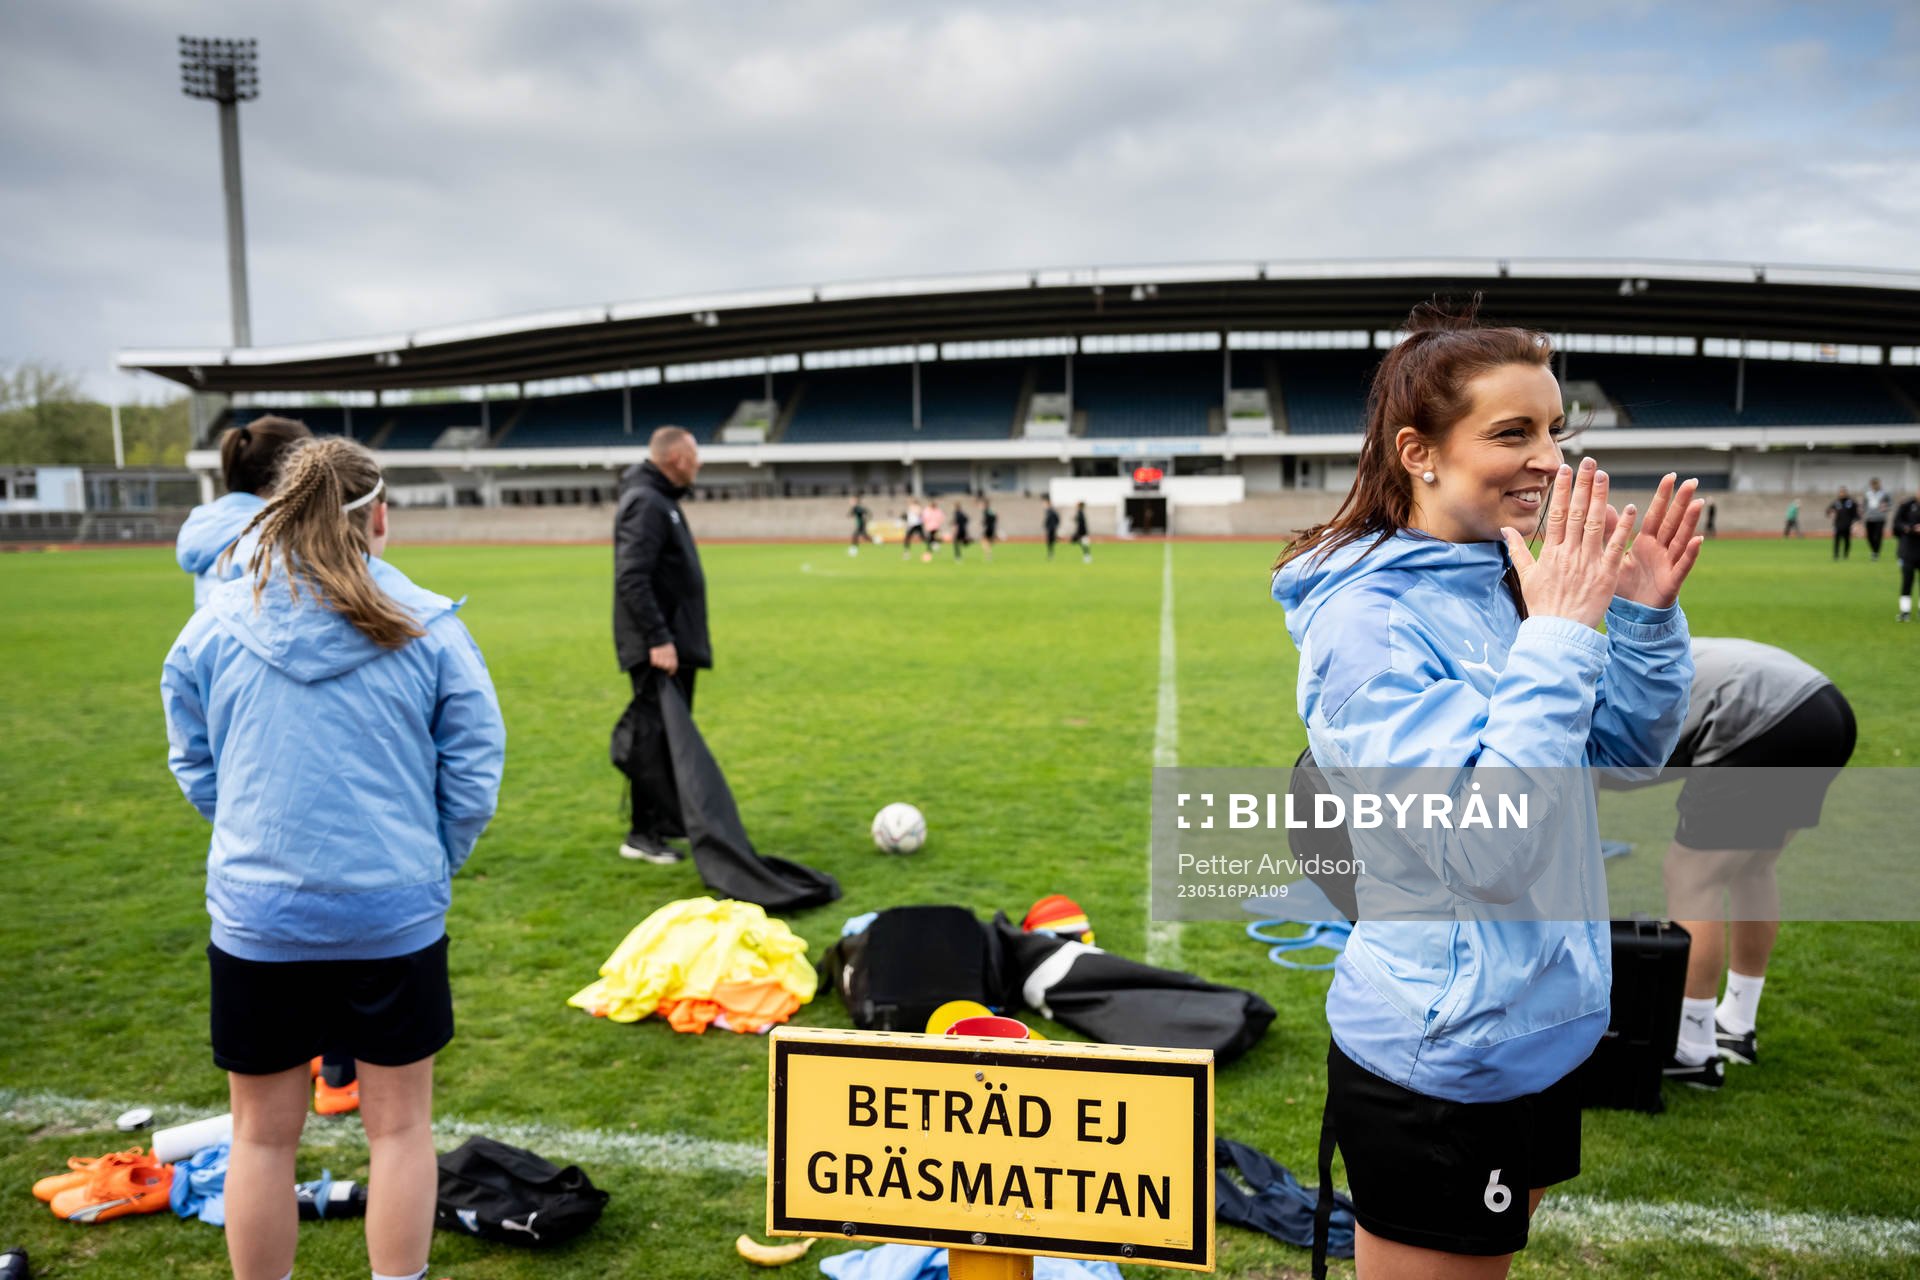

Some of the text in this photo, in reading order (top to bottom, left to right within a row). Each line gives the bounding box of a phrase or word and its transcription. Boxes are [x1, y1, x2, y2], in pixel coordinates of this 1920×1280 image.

[847, 1081, 1128, 1146] BETRÄD EJ
[807, 1145, 1171, 1221] GRÄSMATTAN
[1483, 1168, 1512, 1213] 6
